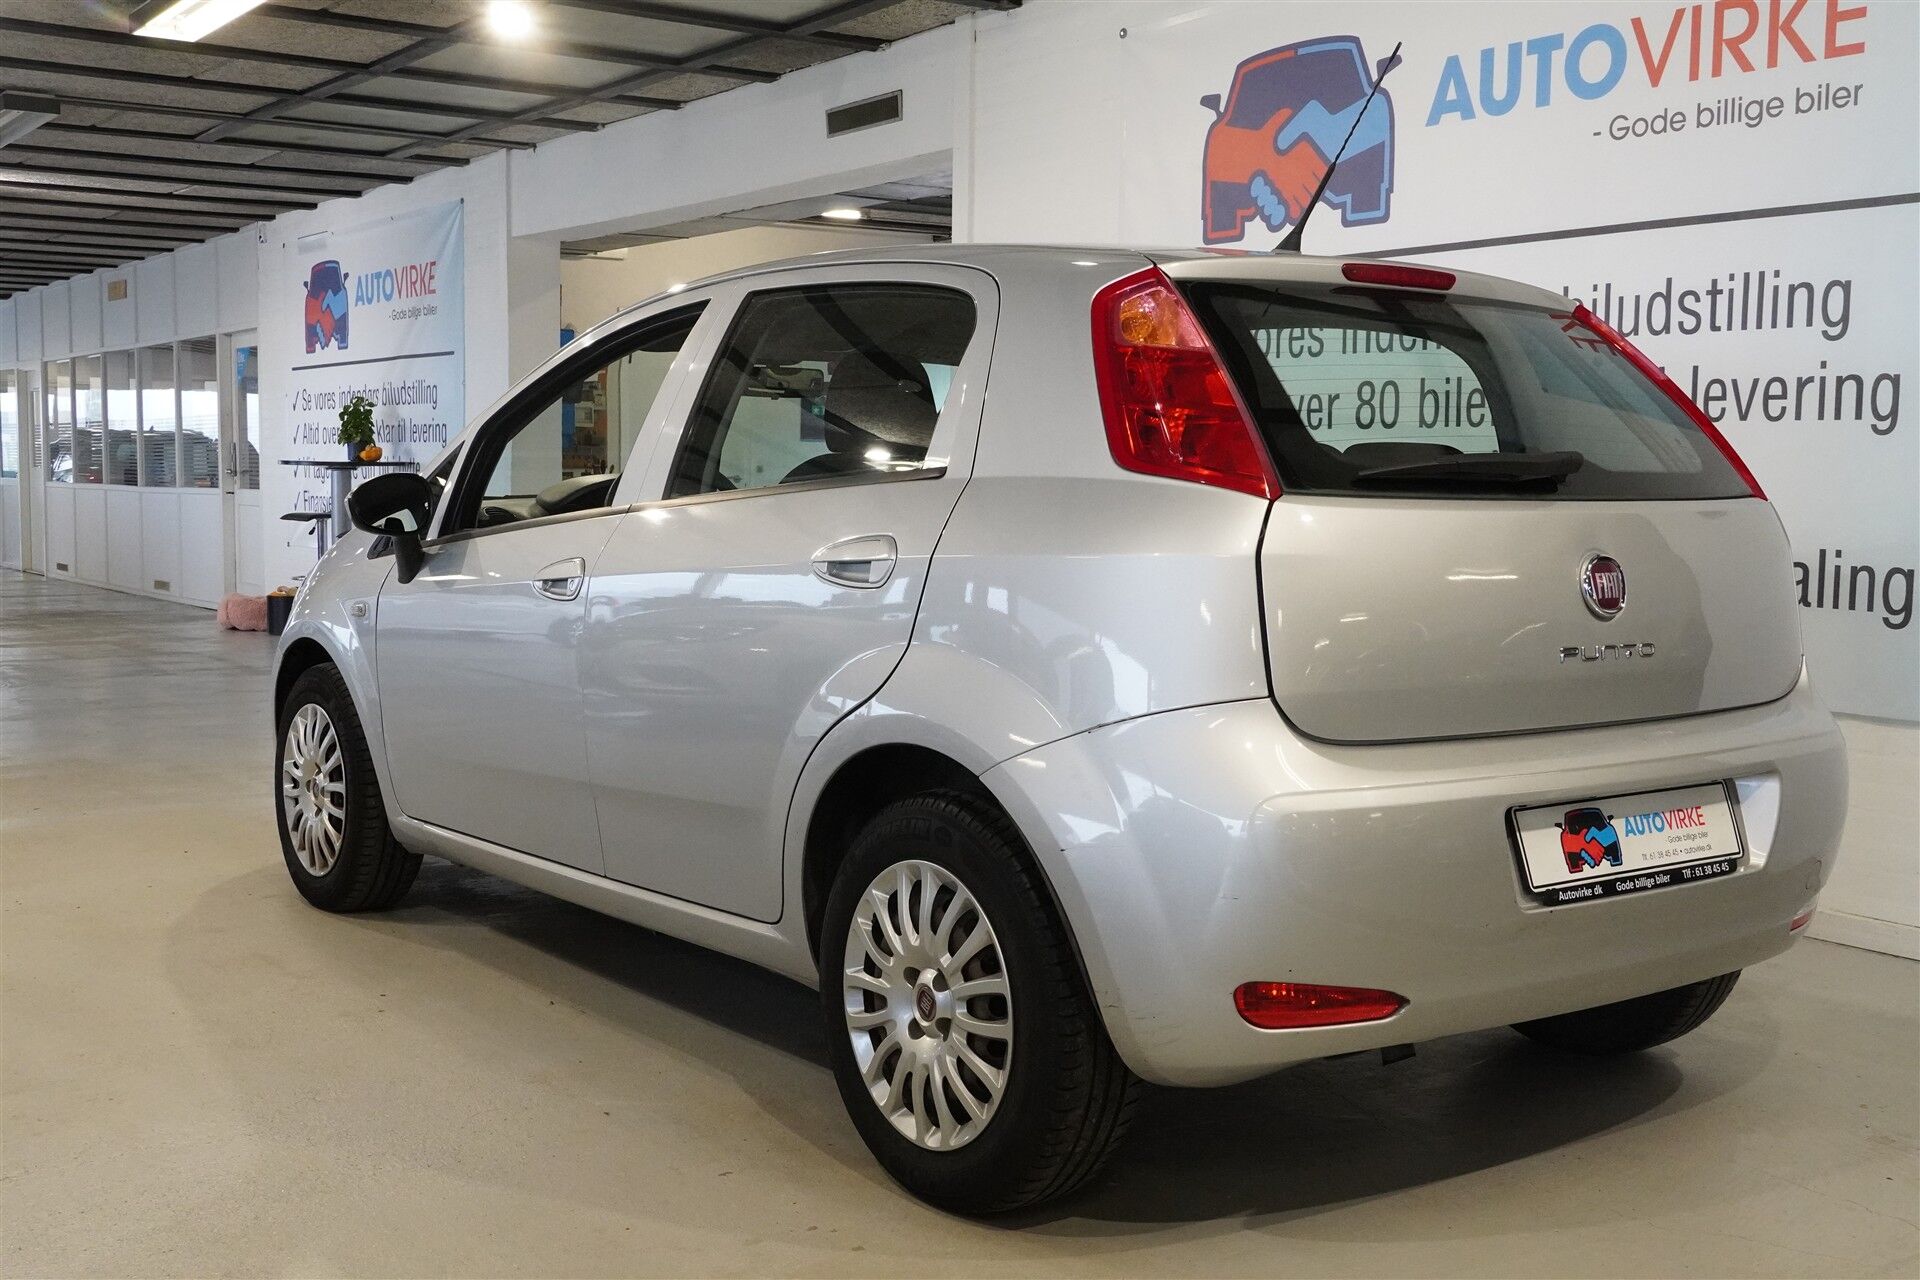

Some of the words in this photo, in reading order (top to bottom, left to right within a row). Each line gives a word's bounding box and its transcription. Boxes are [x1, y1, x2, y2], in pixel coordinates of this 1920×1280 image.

[1425, 0, 1867, 126] AUTOVIRKE
[1608, 107, 1687, 141] Gode
[1696, 96, 1784, 128] billige
[1795, 82, 1864, 115] biler
[355, 261, 436, 307] AUTOVIRKE
[302, 388, 312, 411] Se
[314, 392, 336, 411] vores
[382, 379, 438, 410] biludstilling
[1355, 379, 1400, 430] 80
[1418, 376, 1496, 429] bile
[1691, 360, 1901, 436] levering
[302, 422, 320, 445] Altid
[375, 418, 396, 443] klar
[397, 419, 407, 443] til
[409, 418, 447, 448] levering
[1595, 572, 1619, 599] FIAT
[1792, 549, 1915, 630] aling
[1560, 643, 1655, 663] PUNTO
[1624, 806, 1706, 837] AUTOVIRKE
[1558, 887, 1593, 901] Autovirke
[1616, 879, 1635, 892] Gode
[1635, 876, 1655, 890] billige
[1656, 873, 1671, 885] biler
[1695, 866, 1703, 877] 61
[1704, 864, 1712, 875] 38
[1713, 863, 1721, 873] 45
[1721, 862, 1729, 871] 45
